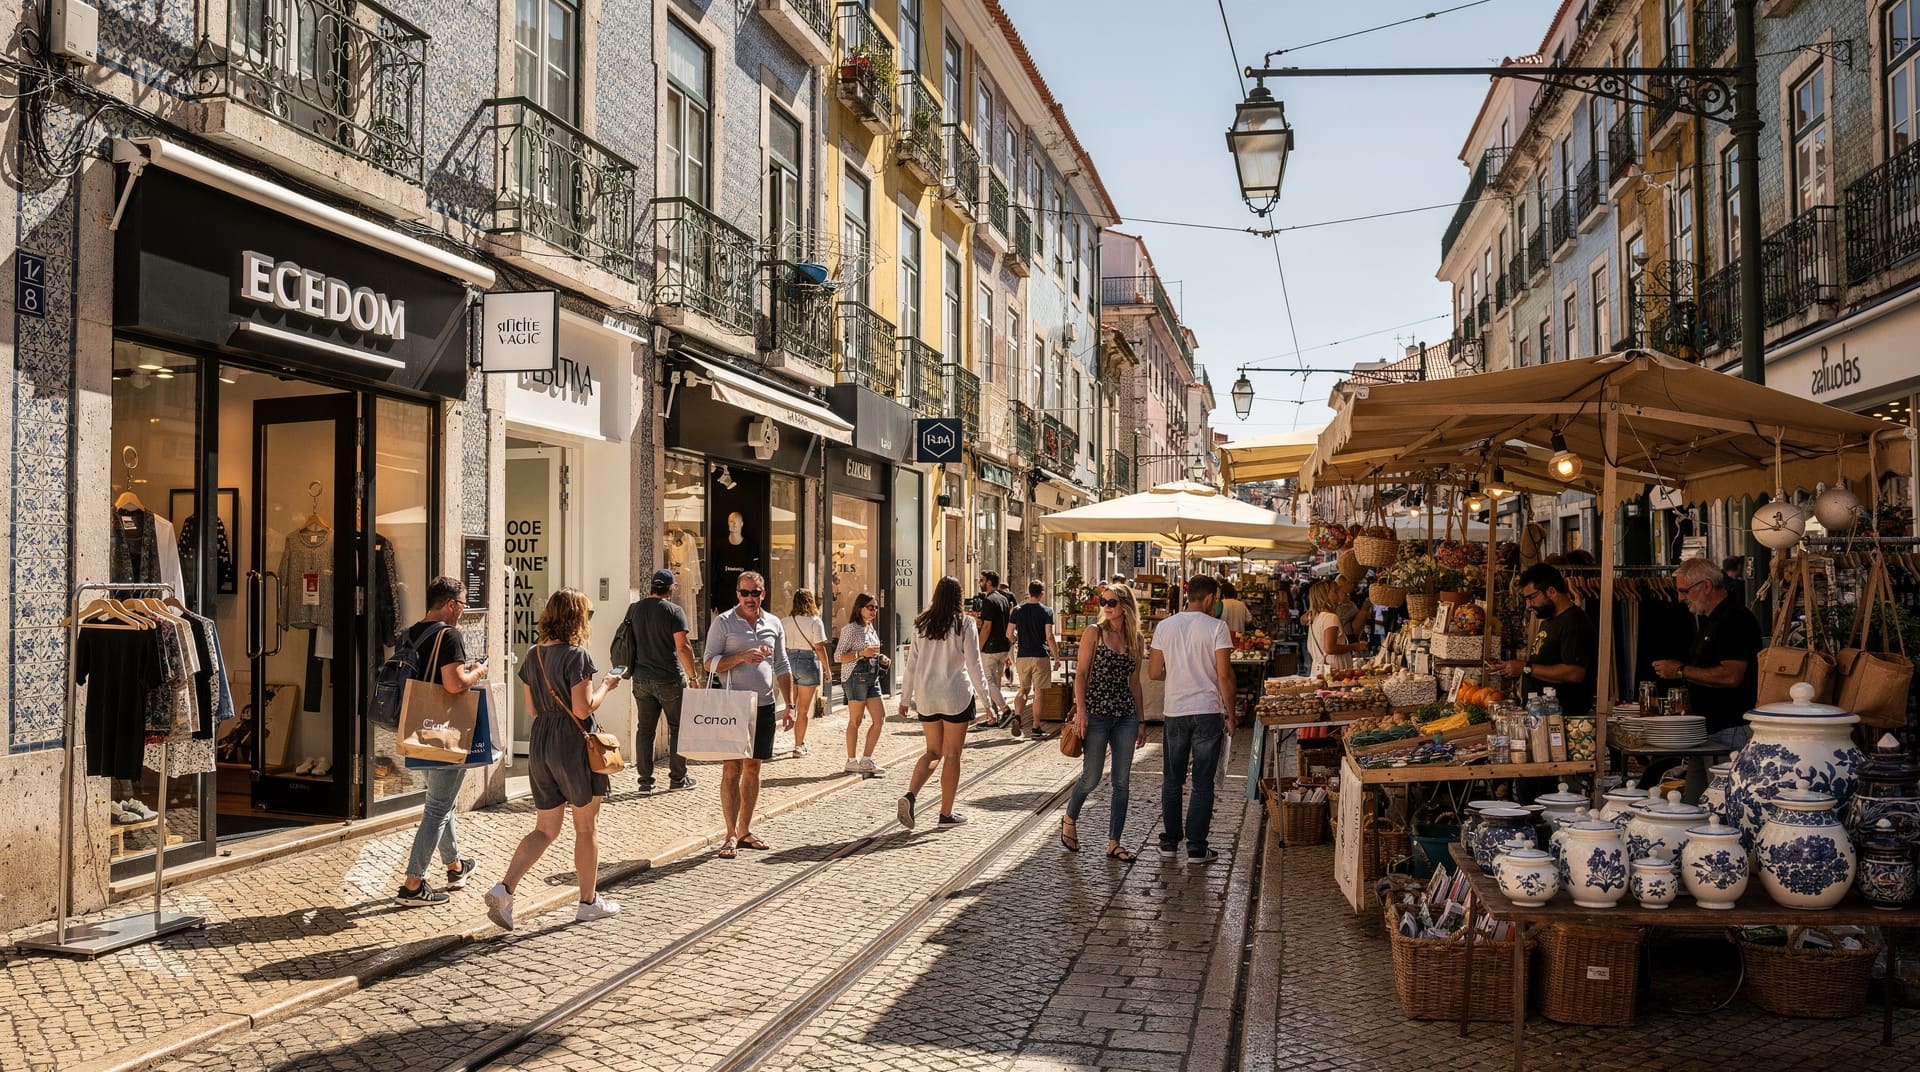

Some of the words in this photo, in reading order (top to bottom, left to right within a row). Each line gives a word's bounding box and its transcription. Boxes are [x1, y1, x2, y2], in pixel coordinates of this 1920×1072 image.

[24, 288, 37, 310] 8
[241, 250, 405, 340] ECEDOM
[507, 520, 541, 535] OOE
[505, 539, 538, 553] OUT
